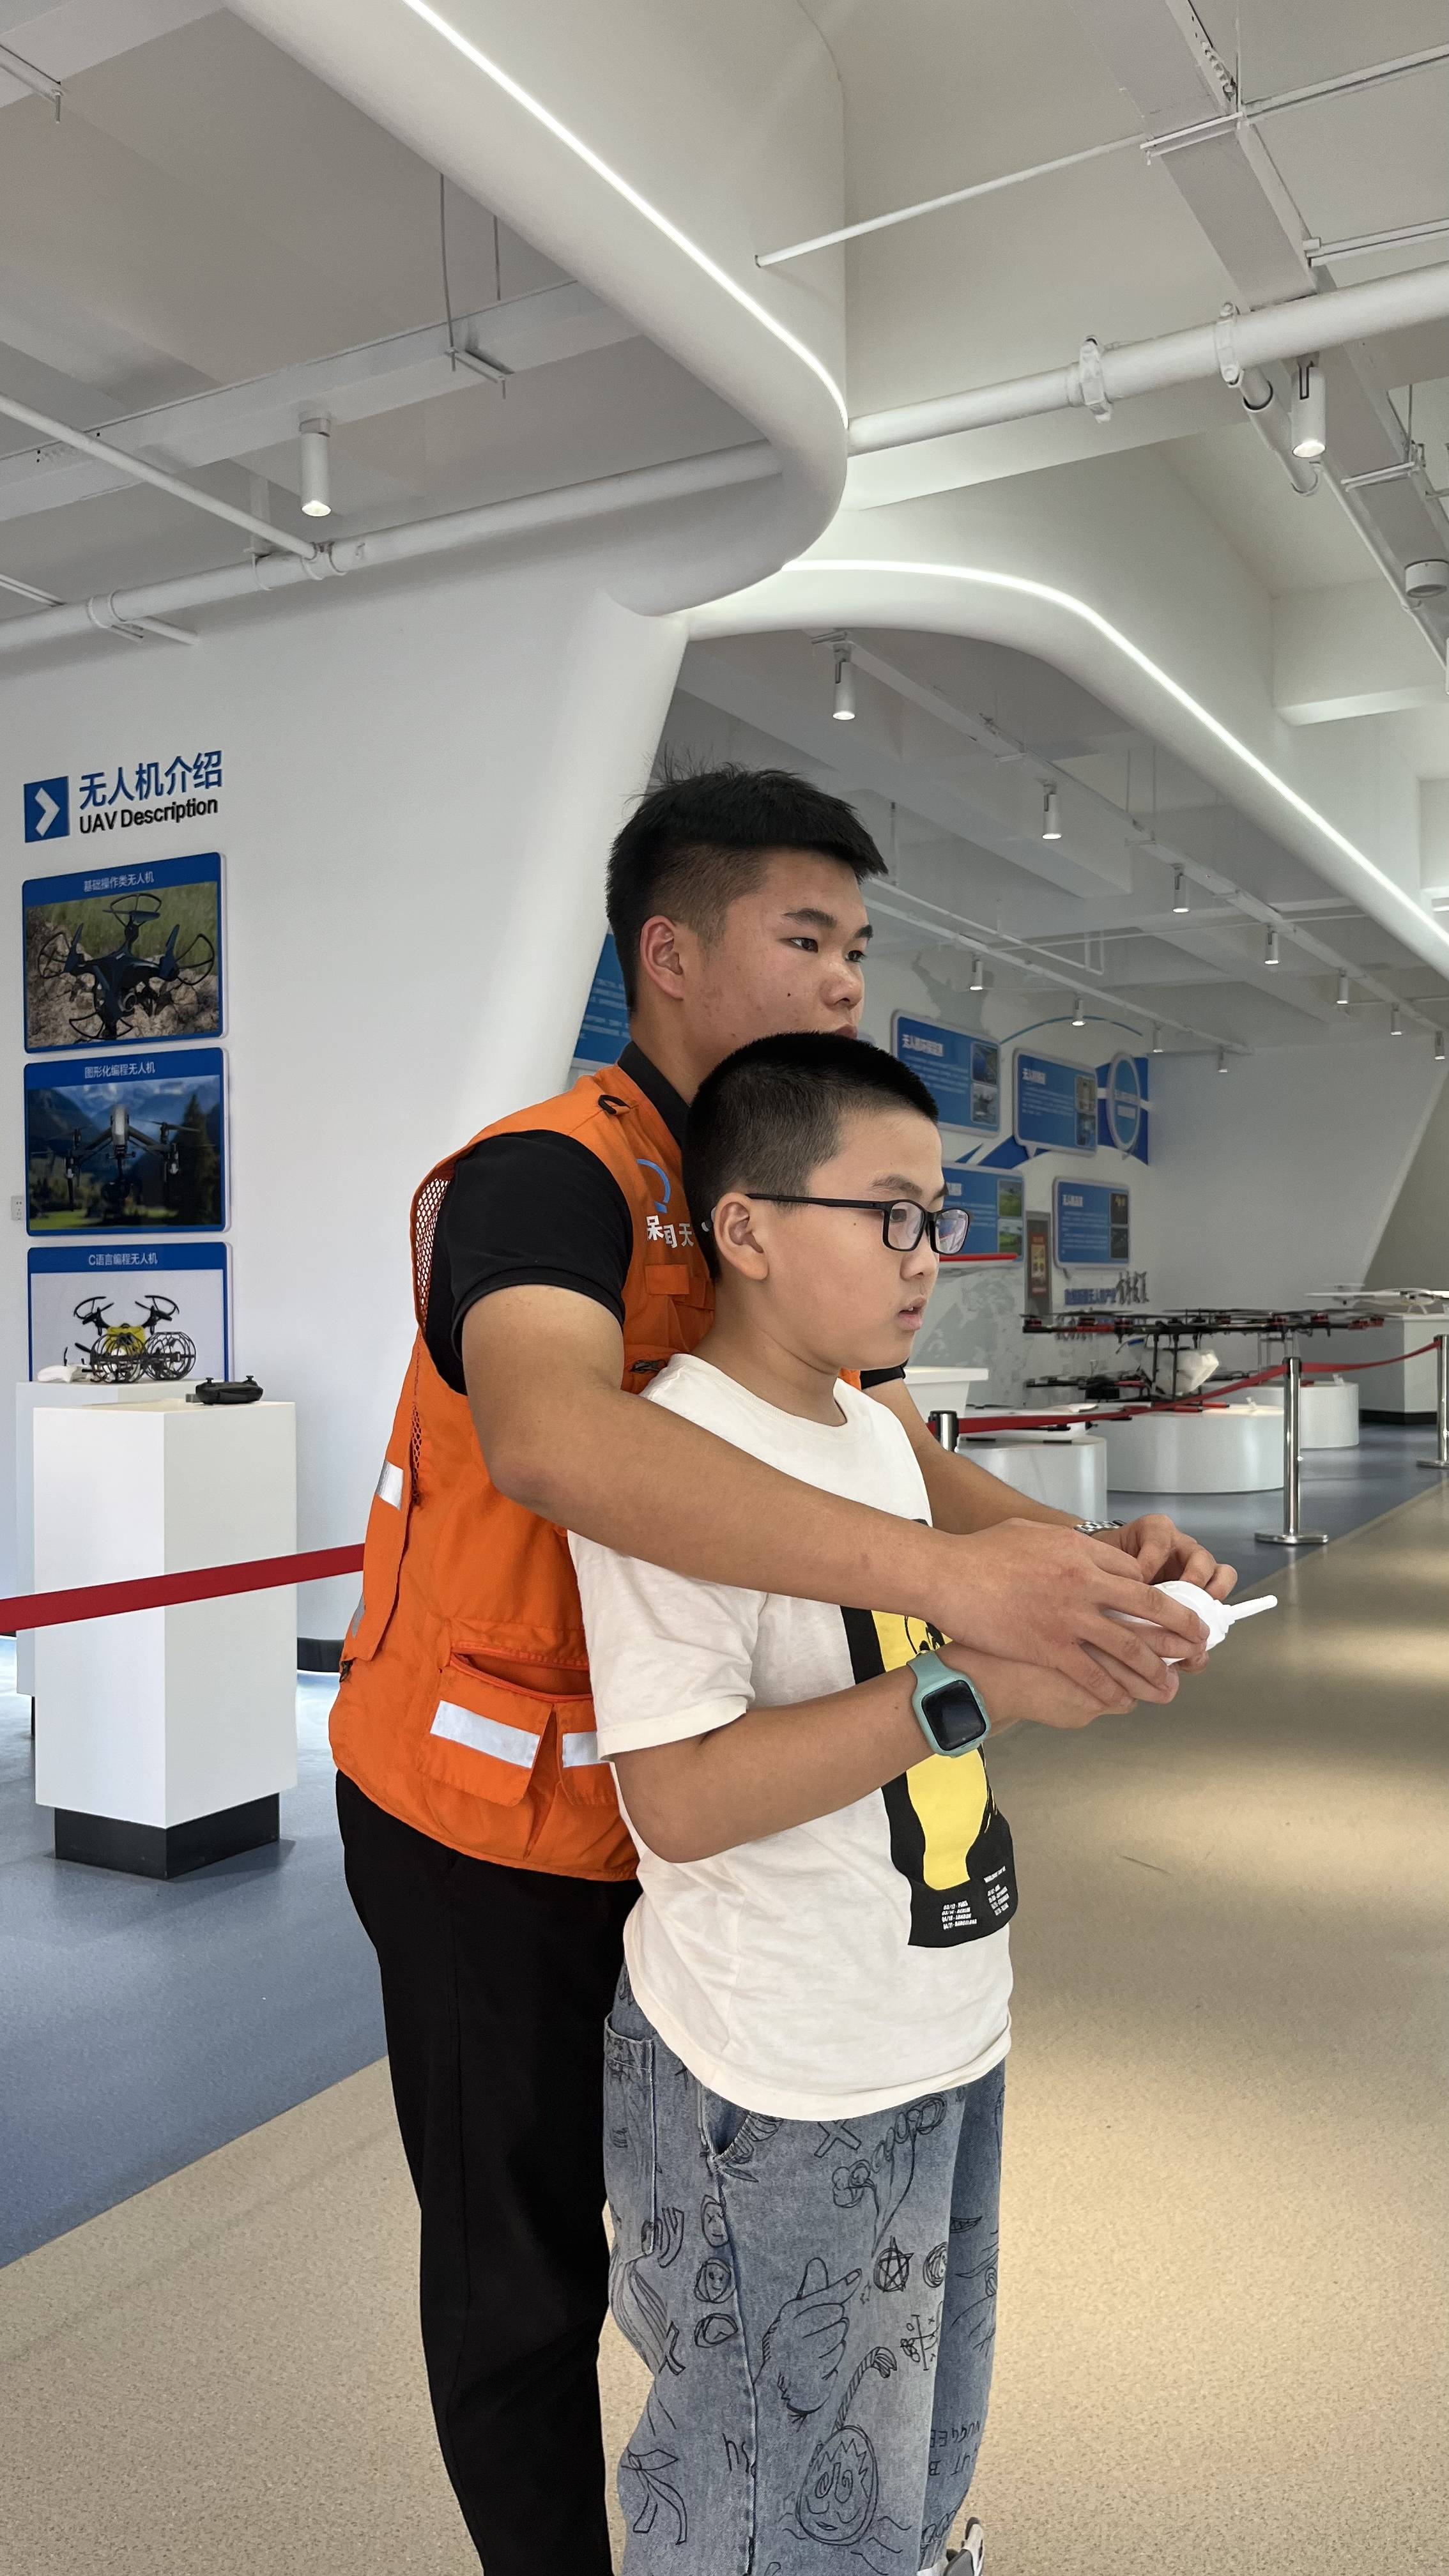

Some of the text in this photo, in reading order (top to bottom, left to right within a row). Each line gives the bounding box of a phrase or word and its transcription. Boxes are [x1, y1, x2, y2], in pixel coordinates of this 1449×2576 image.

[79, 750, 222, 810] 无人机介绍
[79, 798, 218, 834] UAV Description
[84, 871, 155, 893] 基础操作类无人机
[85, 1061, 155, 1079] 图形化编程无人机
[89, 1252, 158, 1266] C语言编程无人机
